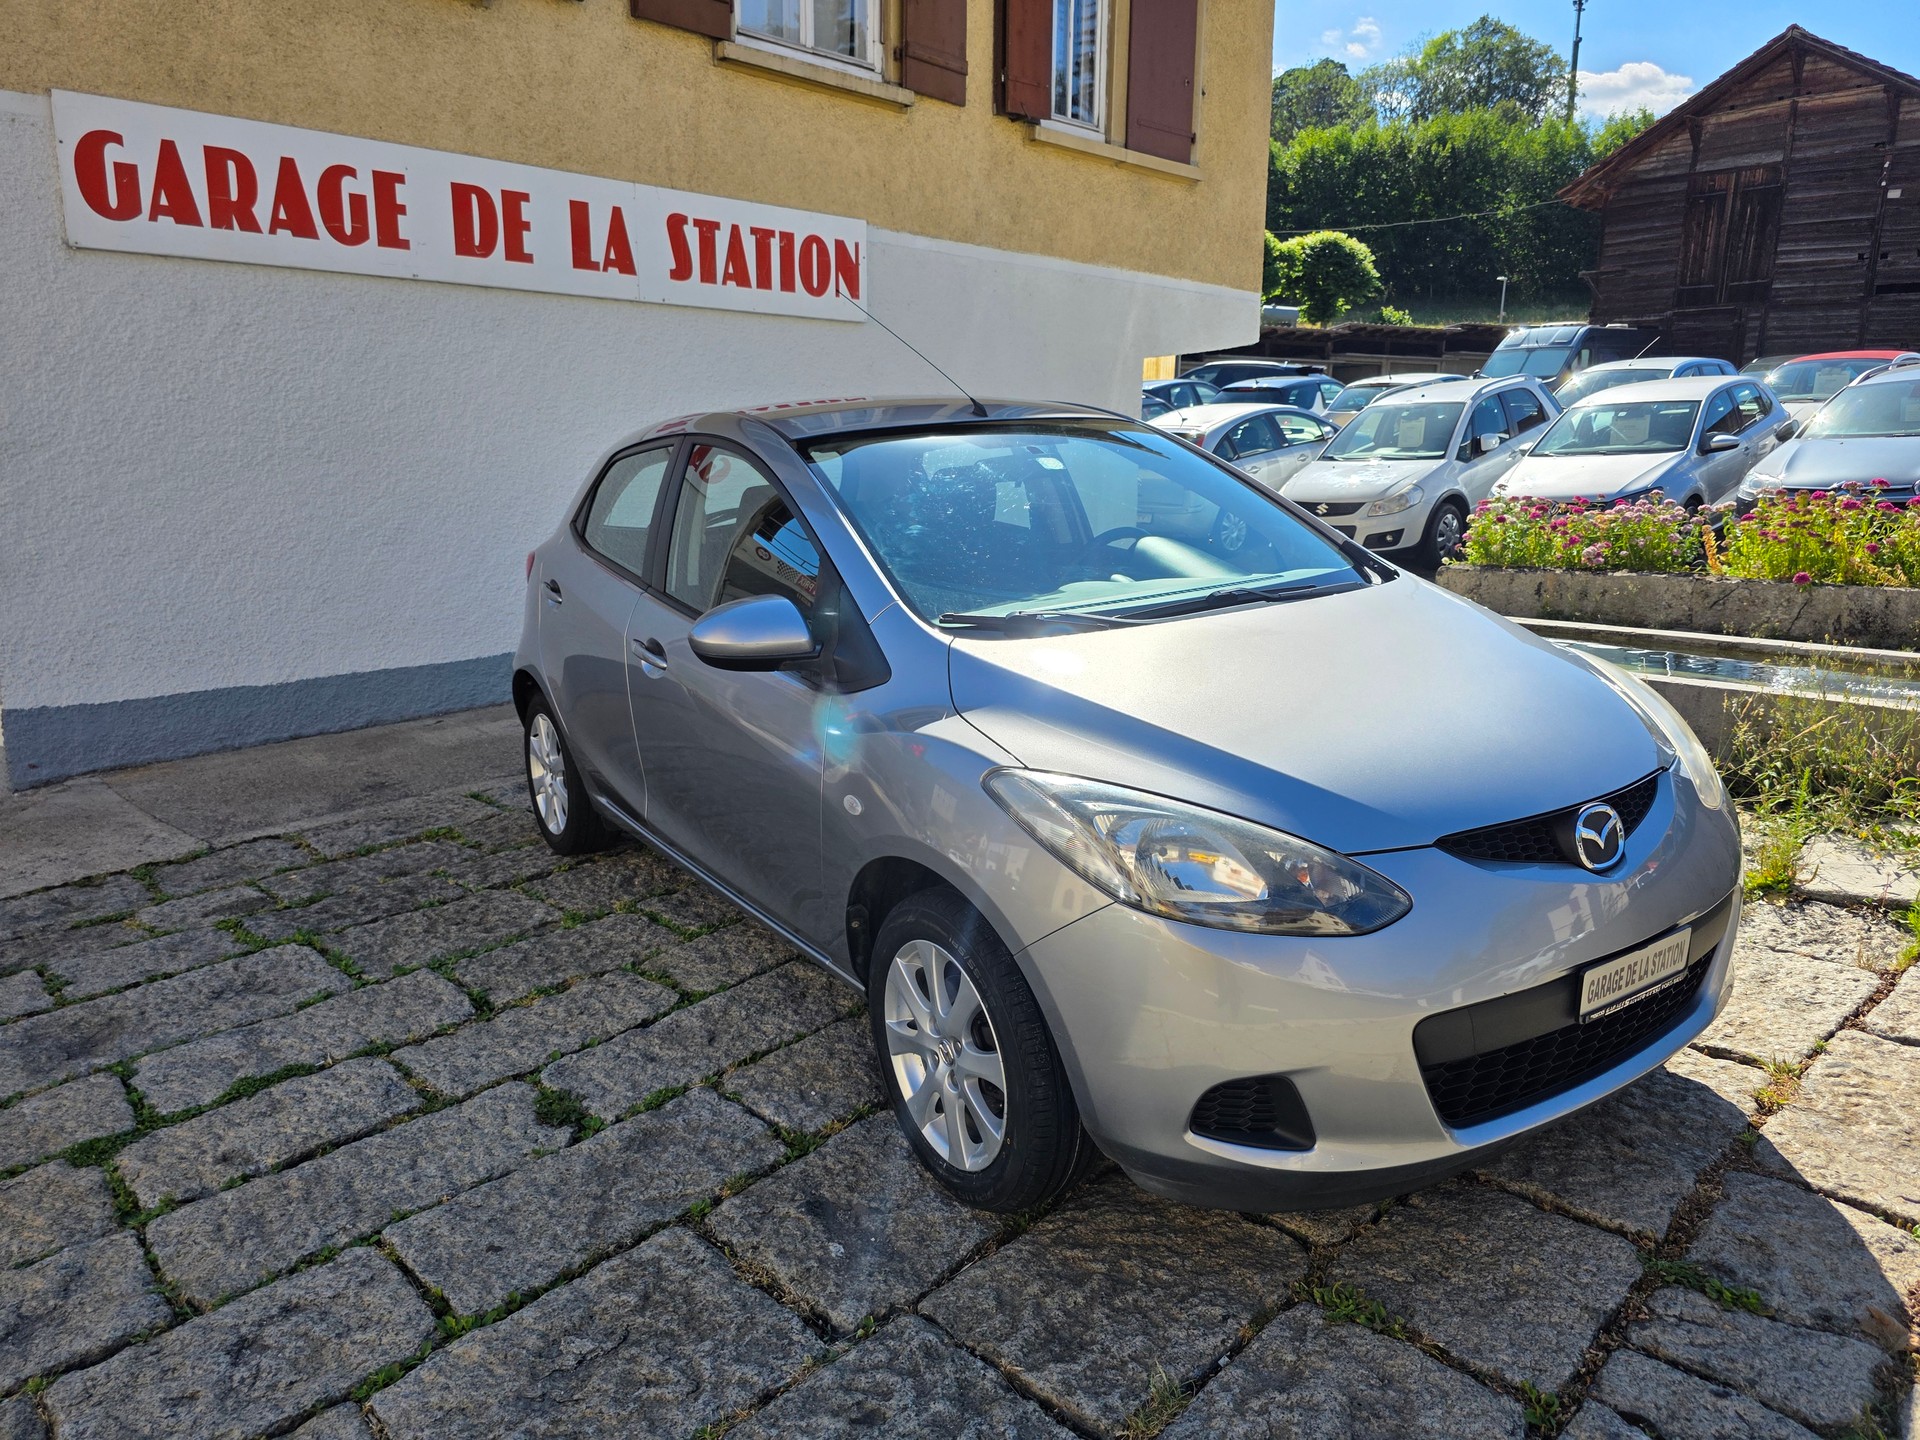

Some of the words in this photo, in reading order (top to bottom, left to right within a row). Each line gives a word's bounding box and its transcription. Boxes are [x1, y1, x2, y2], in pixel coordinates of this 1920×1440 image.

[74, 130, 410, 250] GARAGE
[450, 182, 533, 264] DE
[569, 200, 637, 275] LA
[666, 213, 861, 299] STATION
[1587, 966, 1625, 1004] GARAGE
[1625, 960, 1638, 988] DE
[1638, 956, 1650, 982] LA
[1651, 940, 1686, 976] STATION
